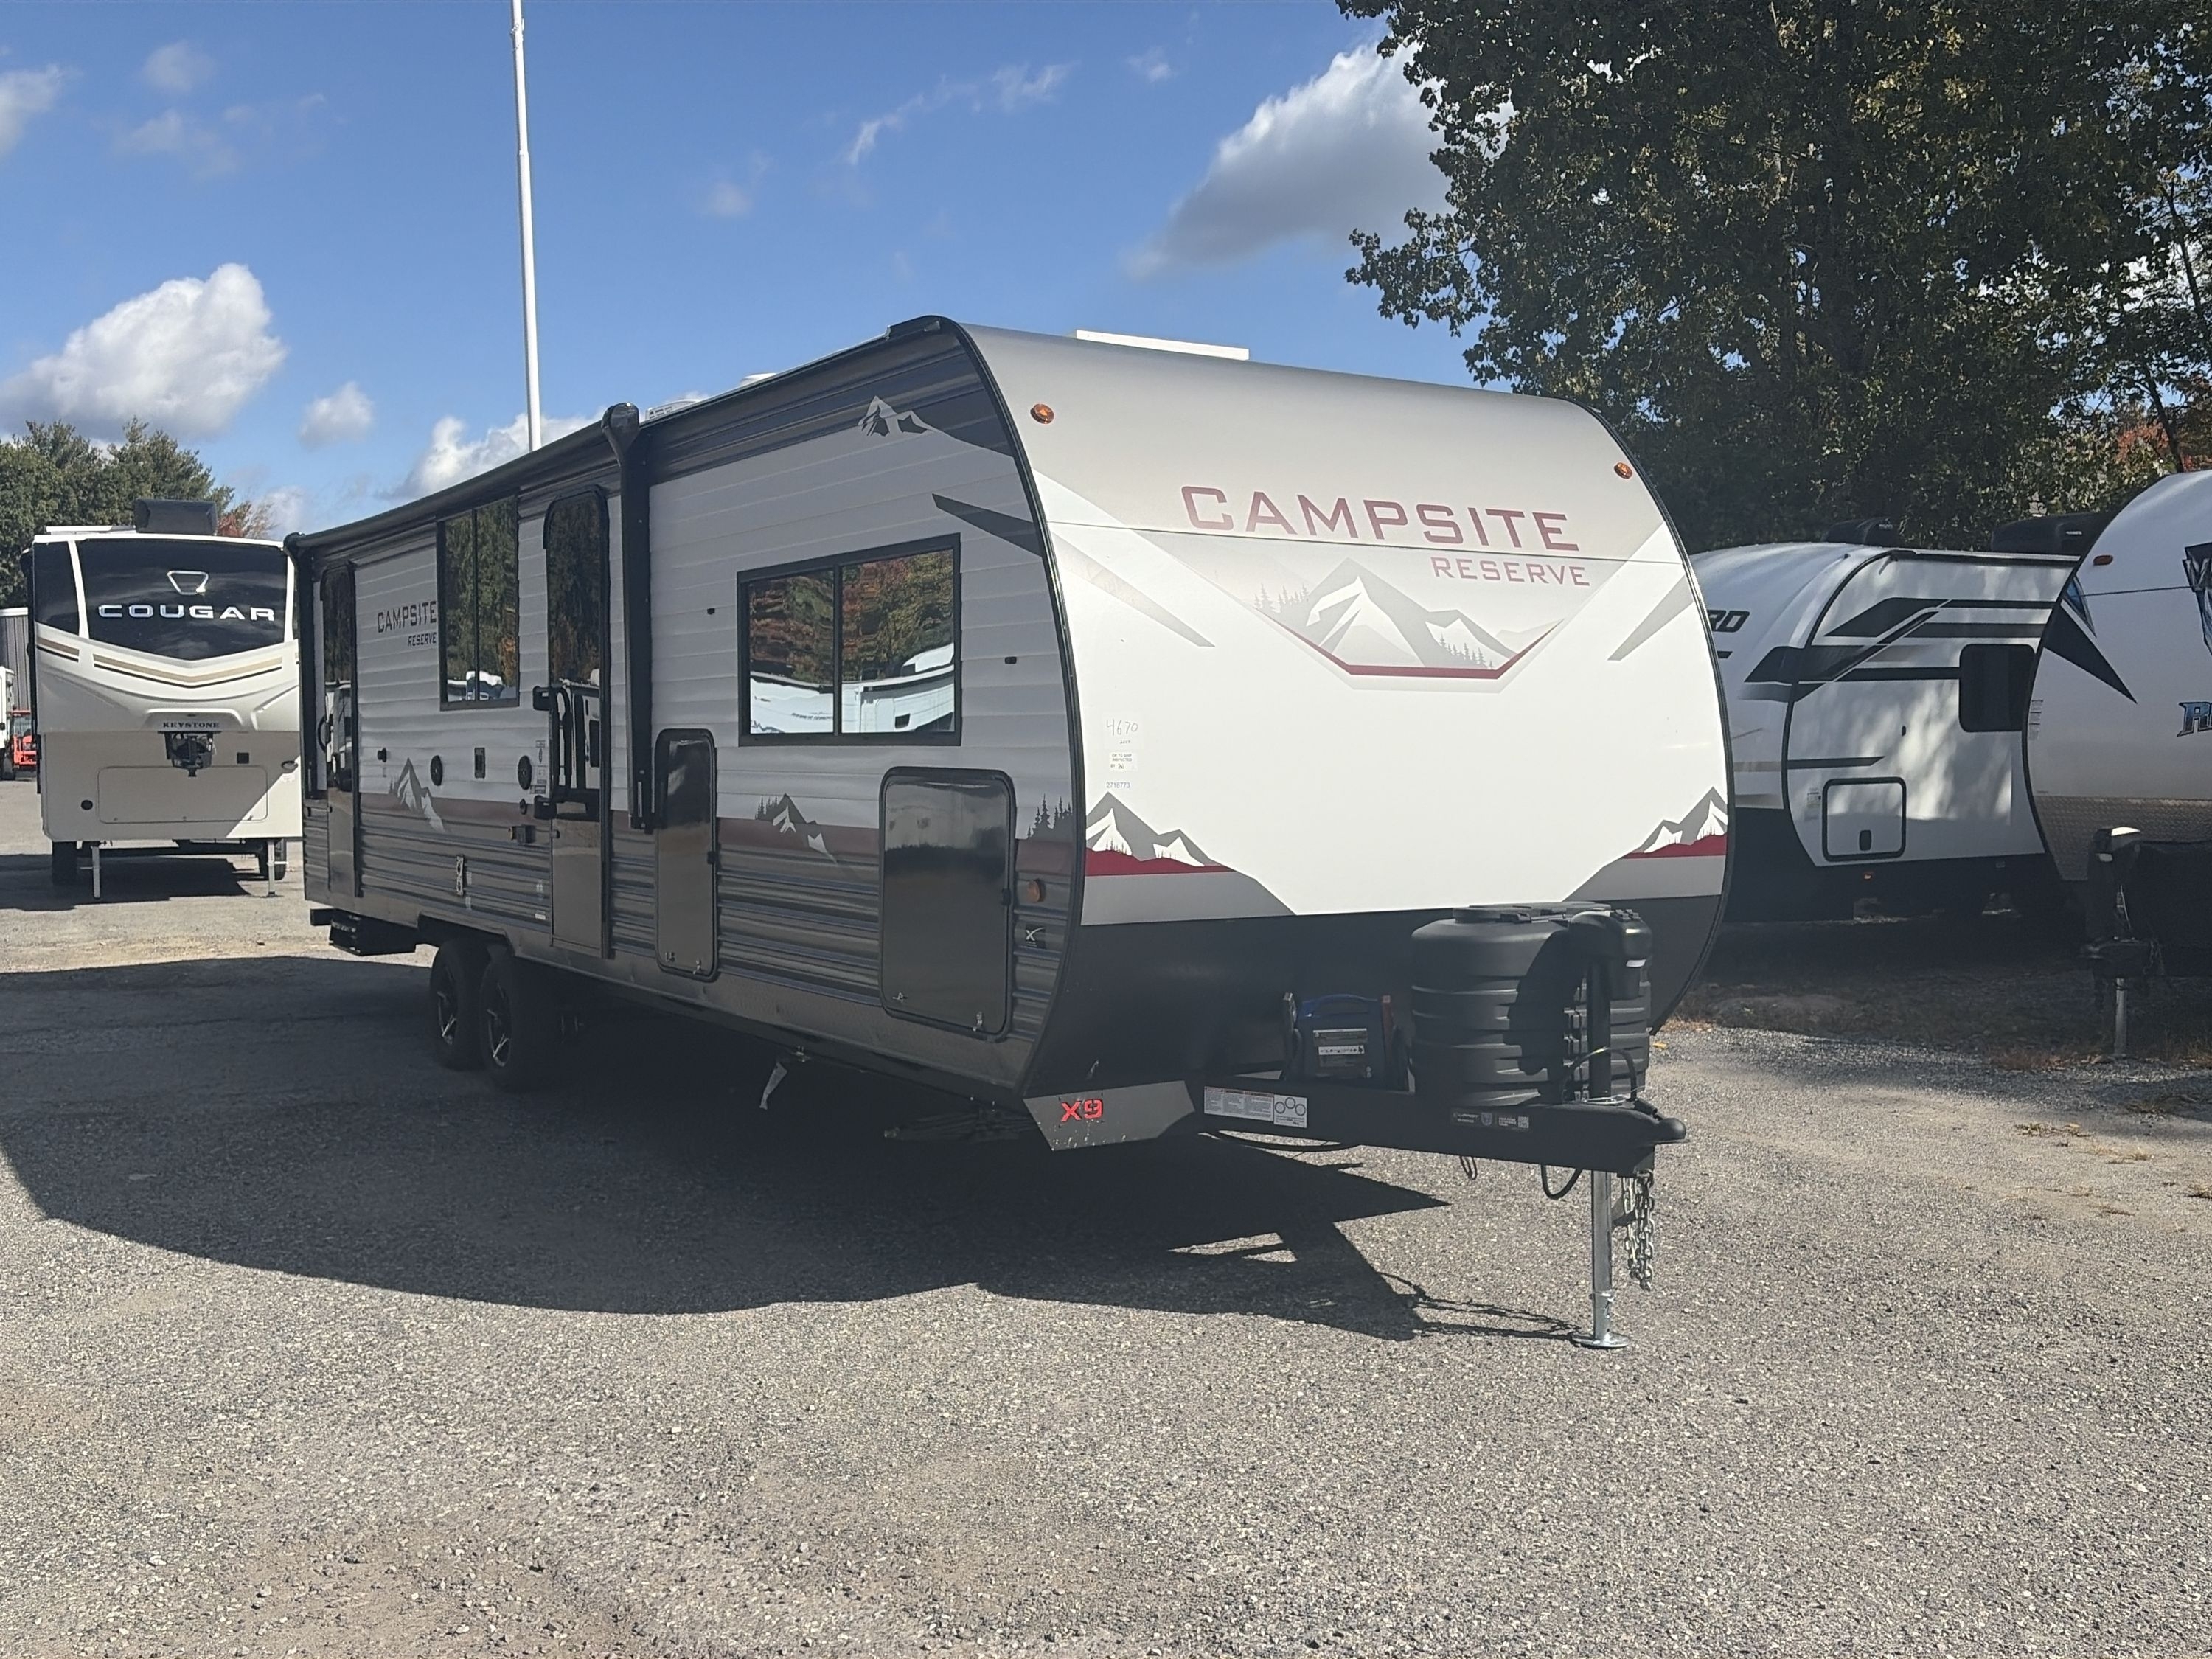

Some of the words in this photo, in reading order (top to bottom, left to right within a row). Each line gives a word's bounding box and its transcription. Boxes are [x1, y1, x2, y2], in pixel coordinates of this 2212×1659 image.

[1181, 486, 1579, 552] CAMPSITE
[1430, 557, 1590, 586] RESERVE
[98, 605, 275, 622] COUGAR
[378, 601, 437, 633] CAMPSITE
[408, 632, 437, 647] RESERVE
[1106, 718, 1139, 737] 4670
[1061, 1097, 1104, 1122] X9
